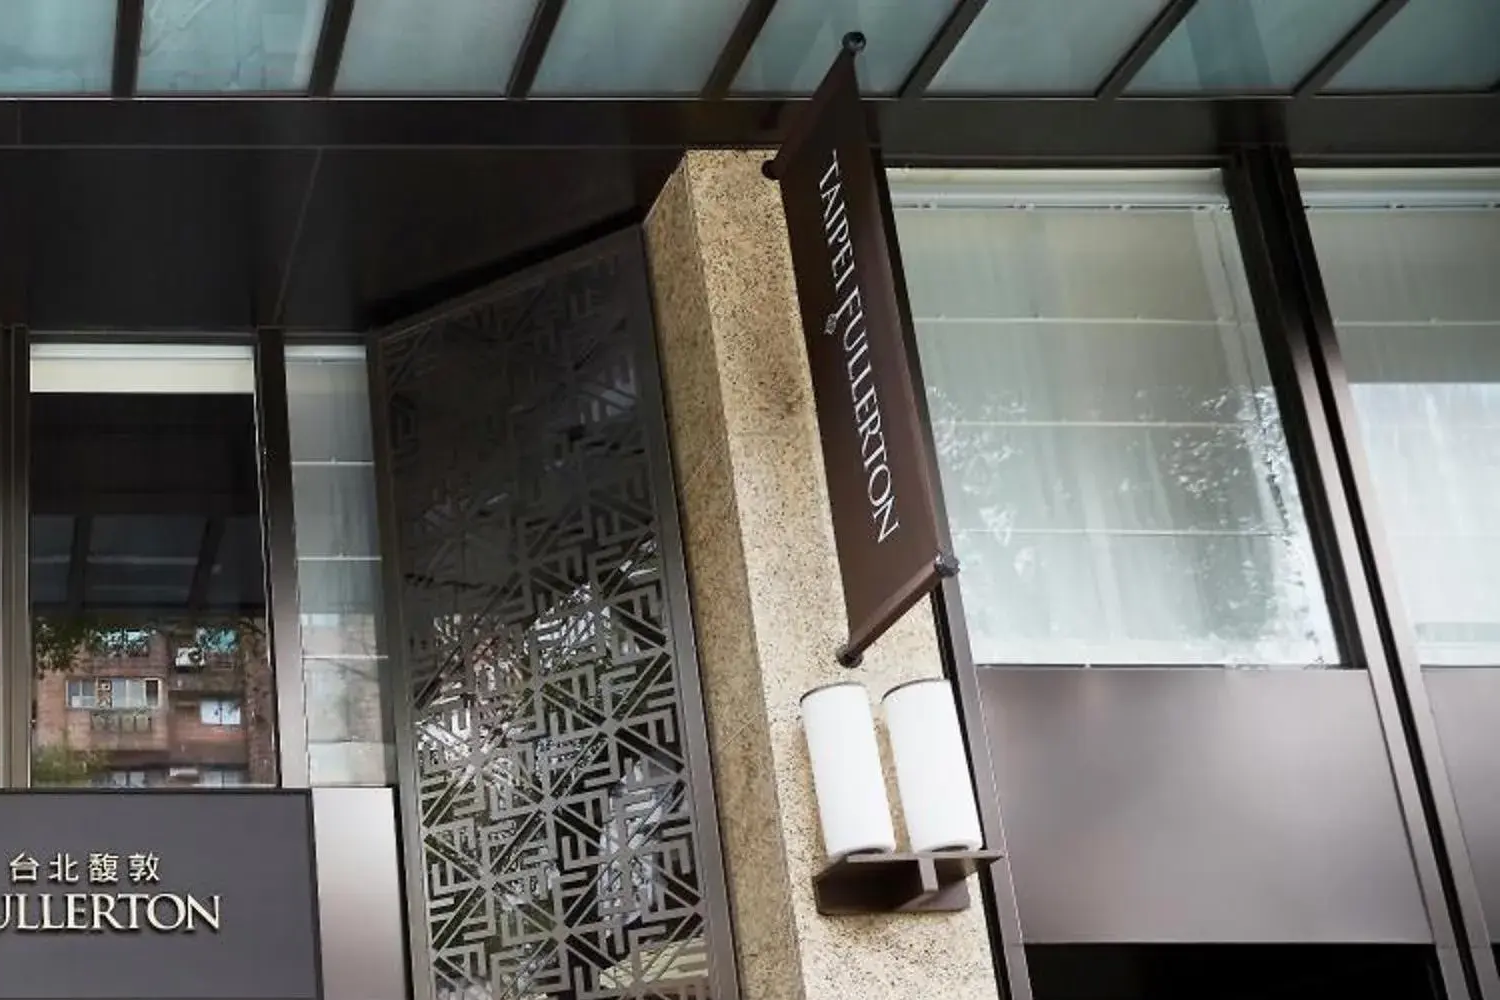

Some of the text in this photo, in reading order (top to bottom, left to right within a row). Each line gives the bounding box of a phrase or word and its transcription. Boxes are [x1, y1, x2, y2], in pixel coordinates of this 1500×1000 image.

[819, 149, 901, 543] TAIPEI FULLERTON
[9, 852, 161, 883] 台北馥敦
